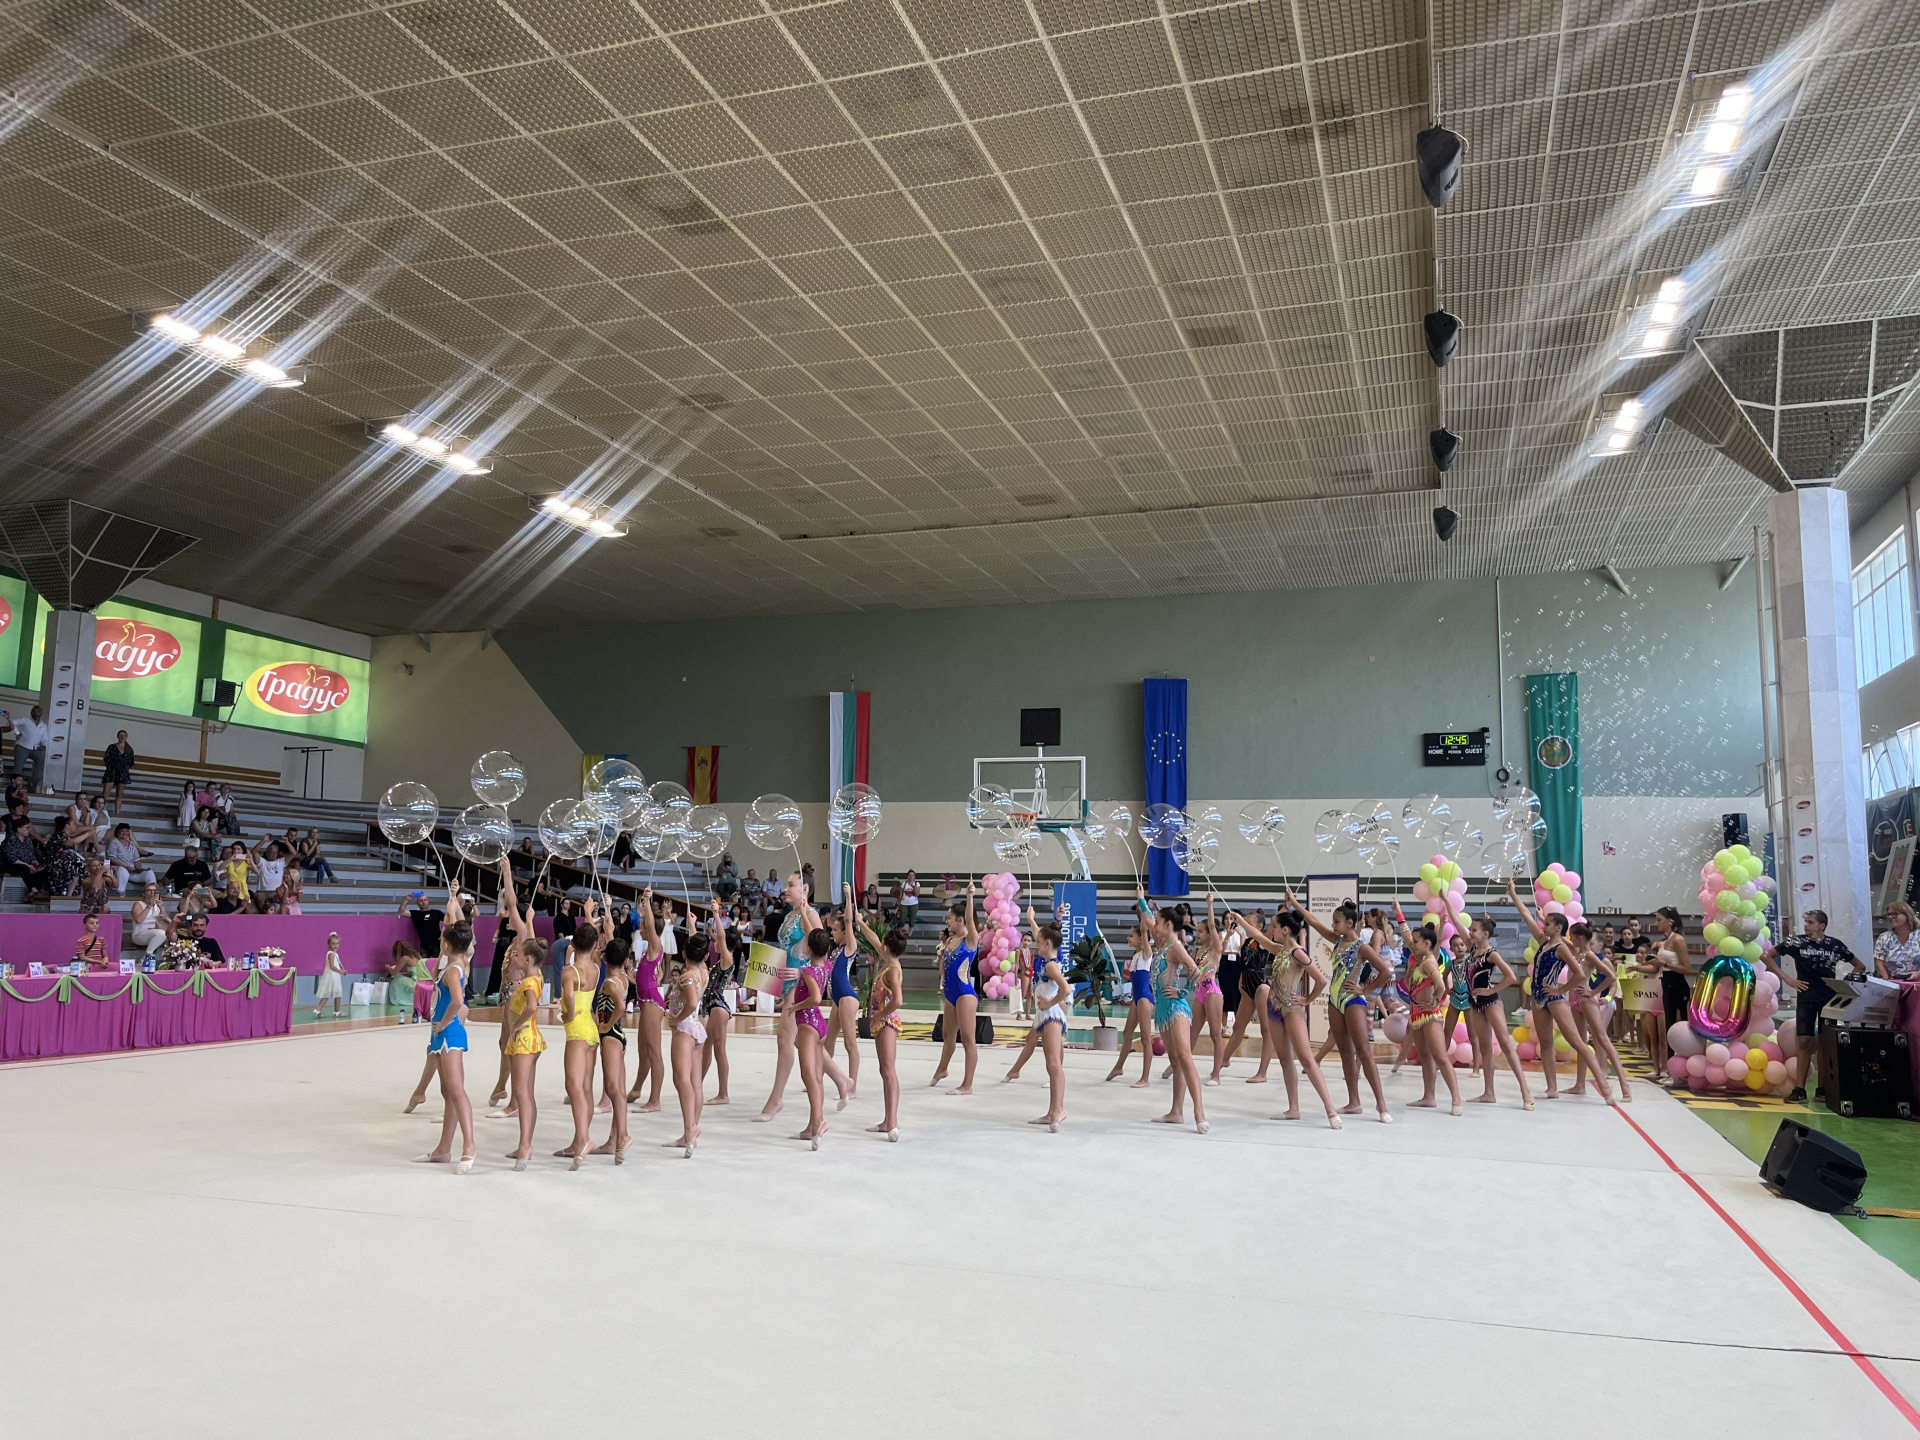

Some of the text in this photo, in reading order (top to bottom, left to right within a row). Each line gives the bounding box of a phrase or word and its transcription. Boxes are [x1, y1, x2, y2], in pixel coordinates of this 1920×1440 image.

[95, 640, 175, 676] адус
[258, 670, 345, 712] Градус
[1445, 735, 1467, 745] 12:45
[752, 961, 783, 979] UKRAINE
[1633, 990, 1659, 999] SPAIN
